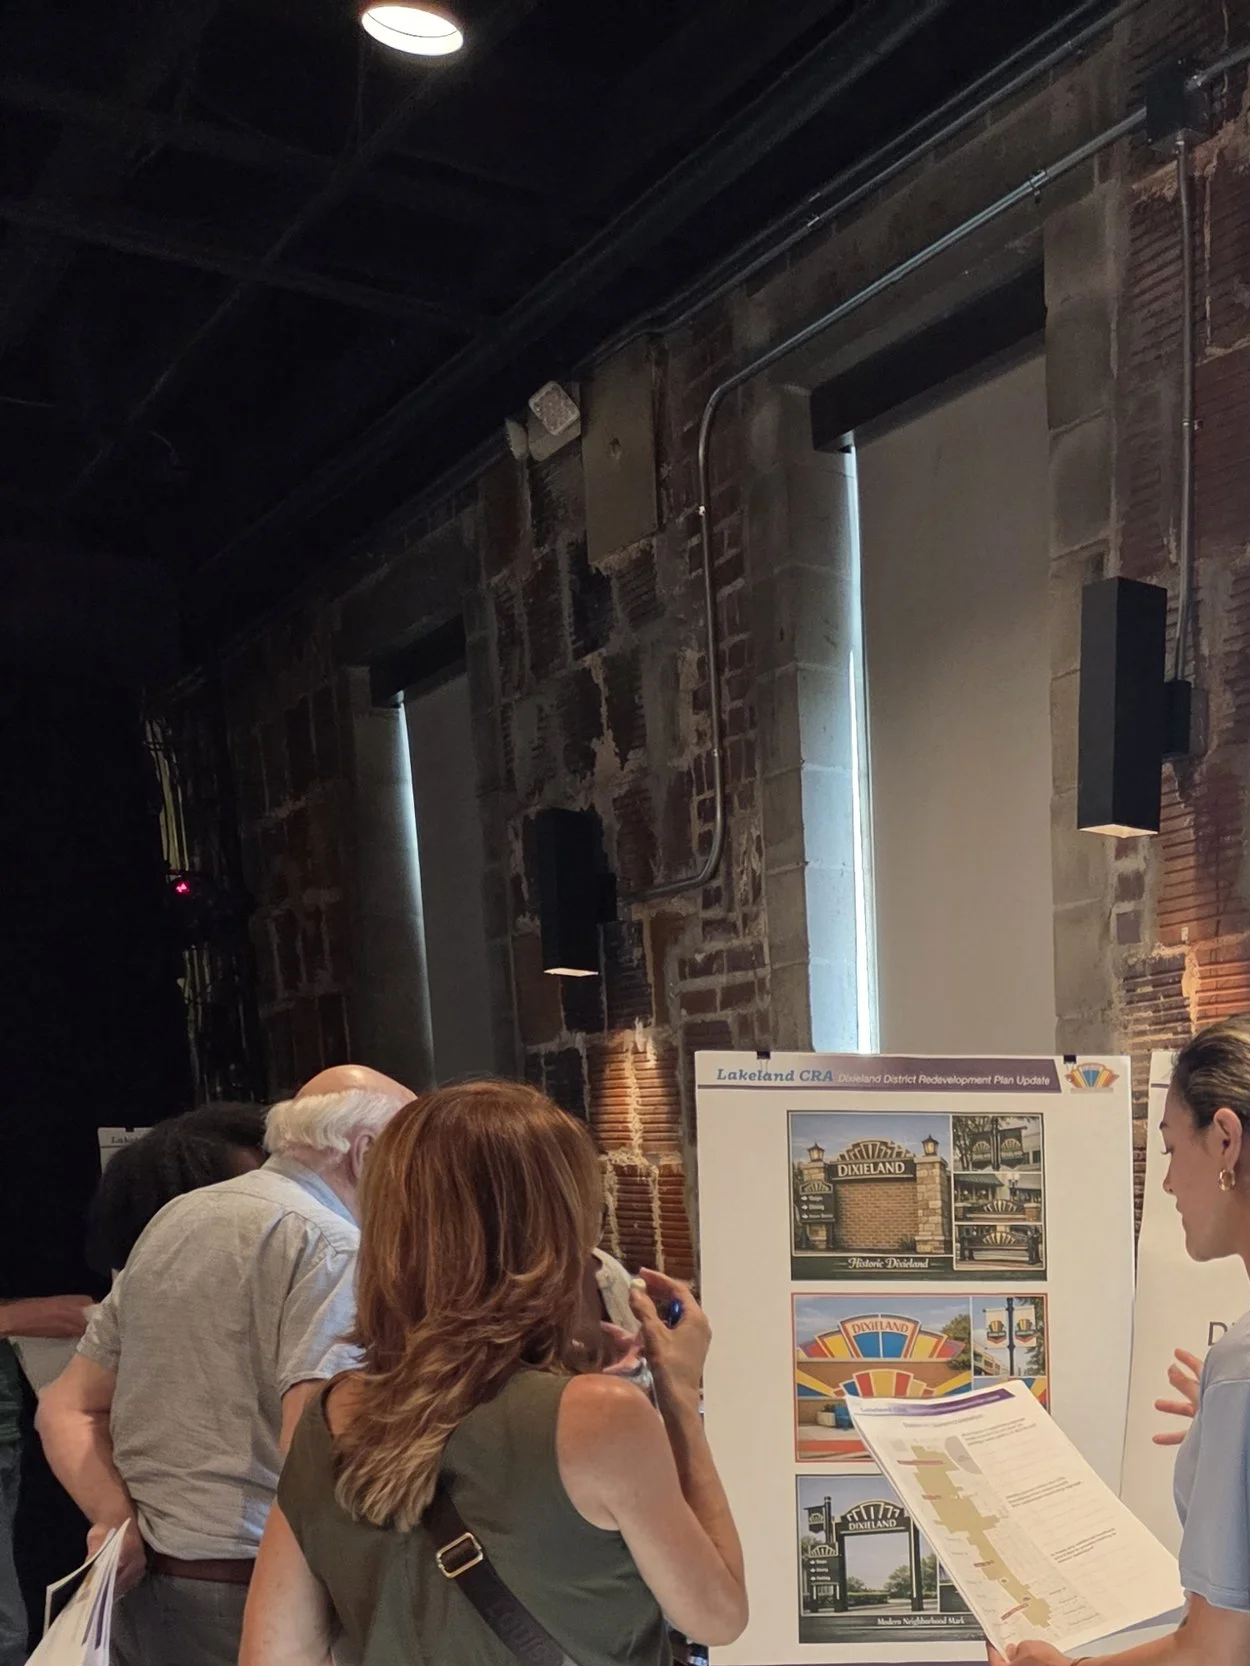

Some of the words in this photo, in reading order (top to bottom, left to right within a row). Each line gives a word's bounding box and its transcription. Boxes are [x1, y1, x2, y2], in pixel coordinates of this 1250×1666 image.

[717, 1068, 795, 1082] Lakeland
[799, 1069, 833, 1082] CRA
[883, 1074, 917, 1085] District
[918, 1074, 992, 1086] Redevelopment
[993, 1075, 1014, 1085] Plan
[1016, 1076, 1050, 1087] Update
[837, 1161, 905, 1177] DIXIELAND
[847, 1257, 884, 1269] Historic
[885, 1257, 929, 1269] Dixieland
